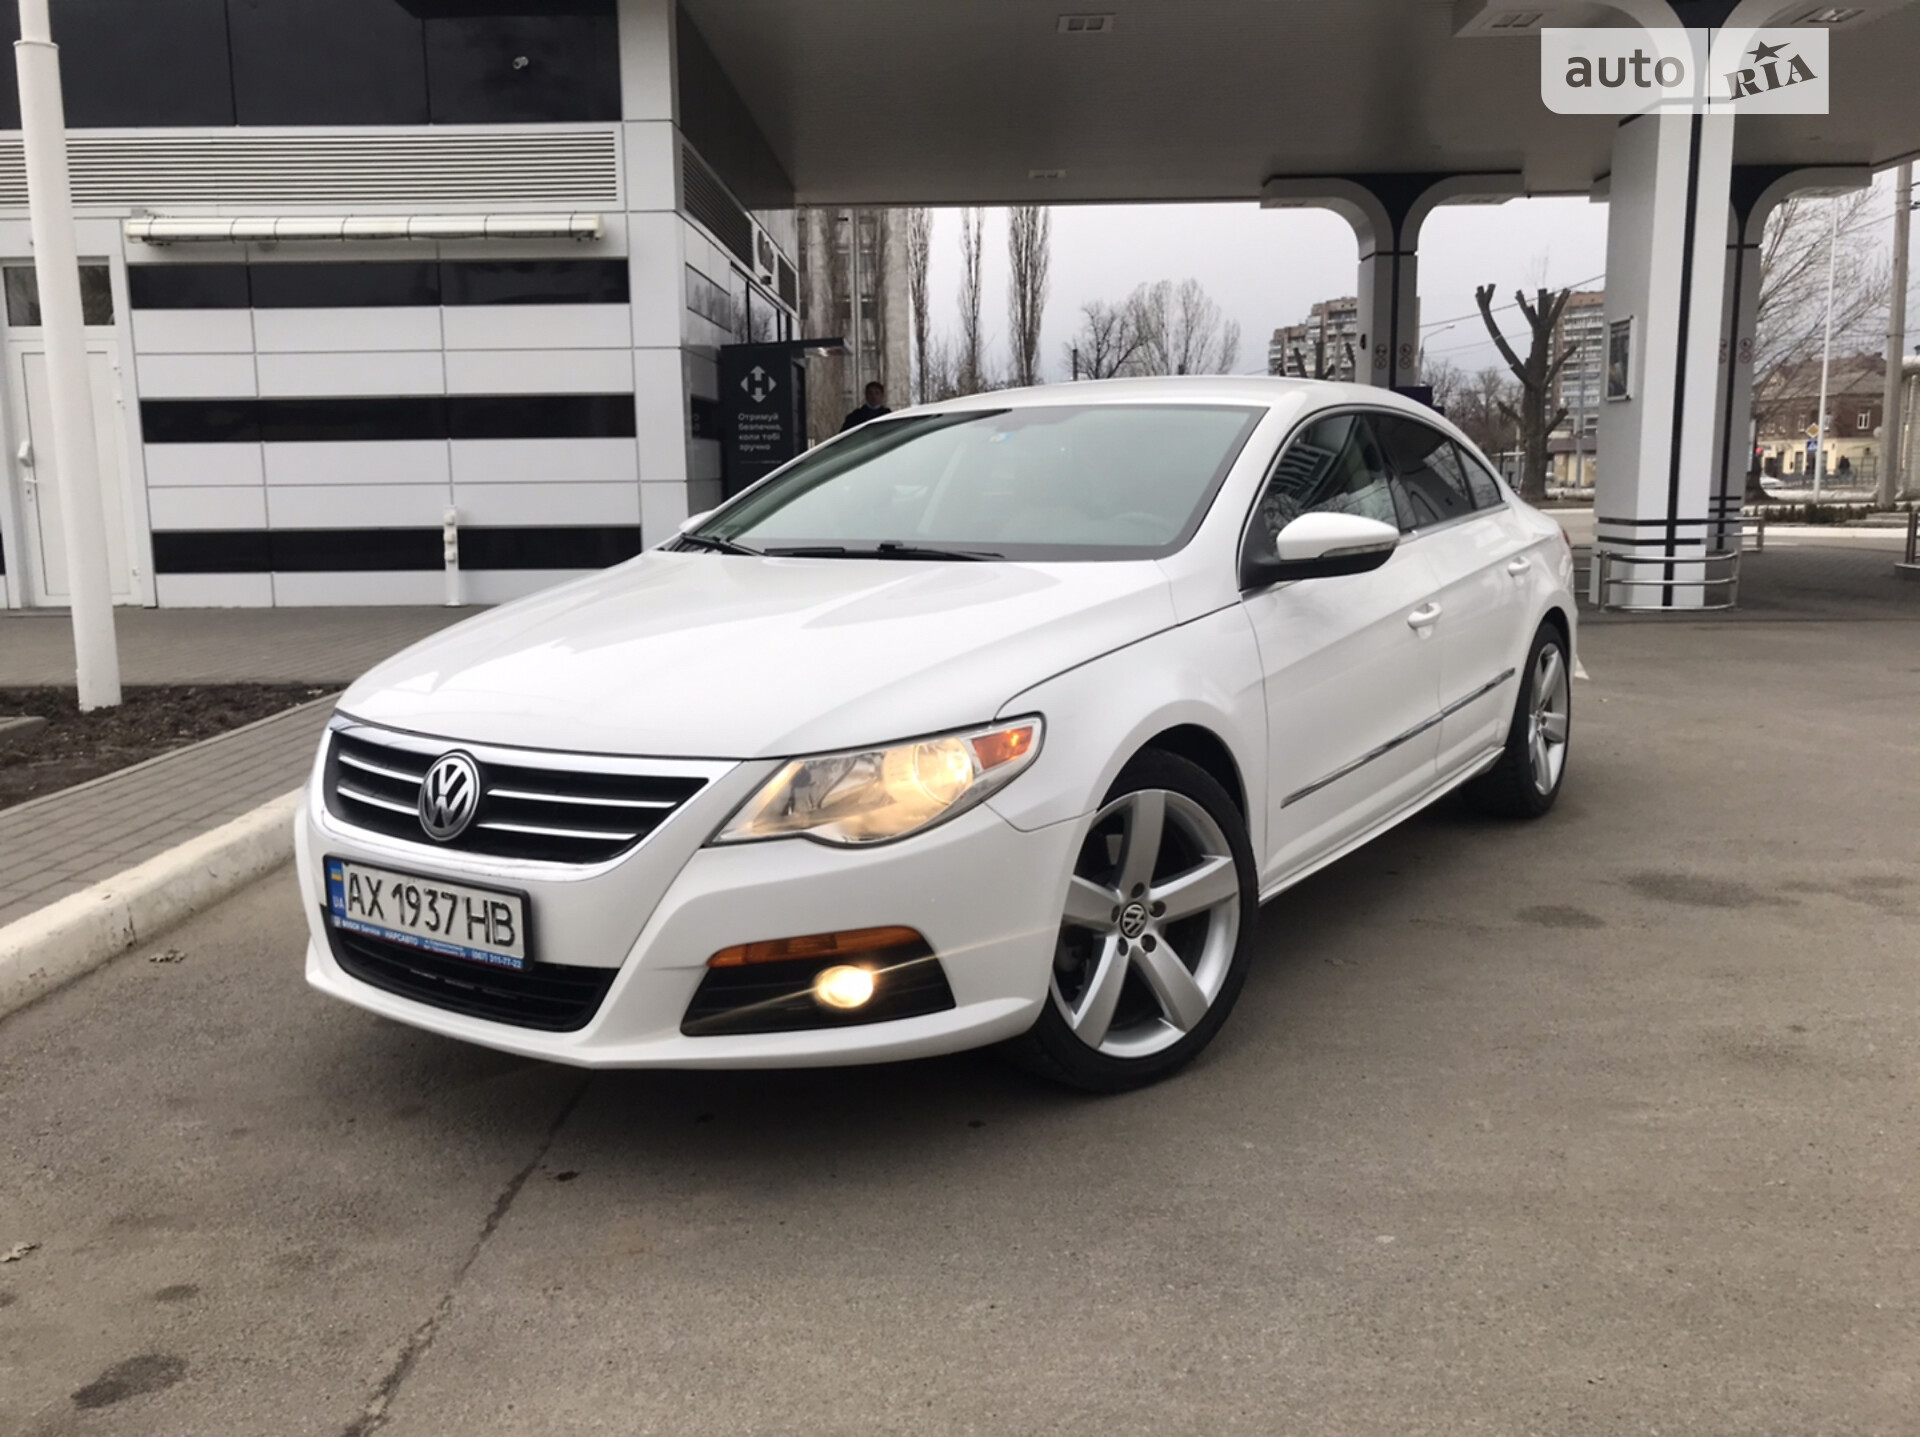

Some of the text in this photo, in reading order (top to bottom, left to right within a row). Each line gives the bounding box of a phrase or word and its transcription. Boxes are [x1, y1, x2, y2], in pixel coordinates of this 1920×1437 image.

[737, 412, 779, 422] Отримуй
[738, 432, 781, 441] коли тобі
[739, 443, 771, 452] зручно
[332, 895, 345, 909] UA
[391, 882, 458, 935] 1937
